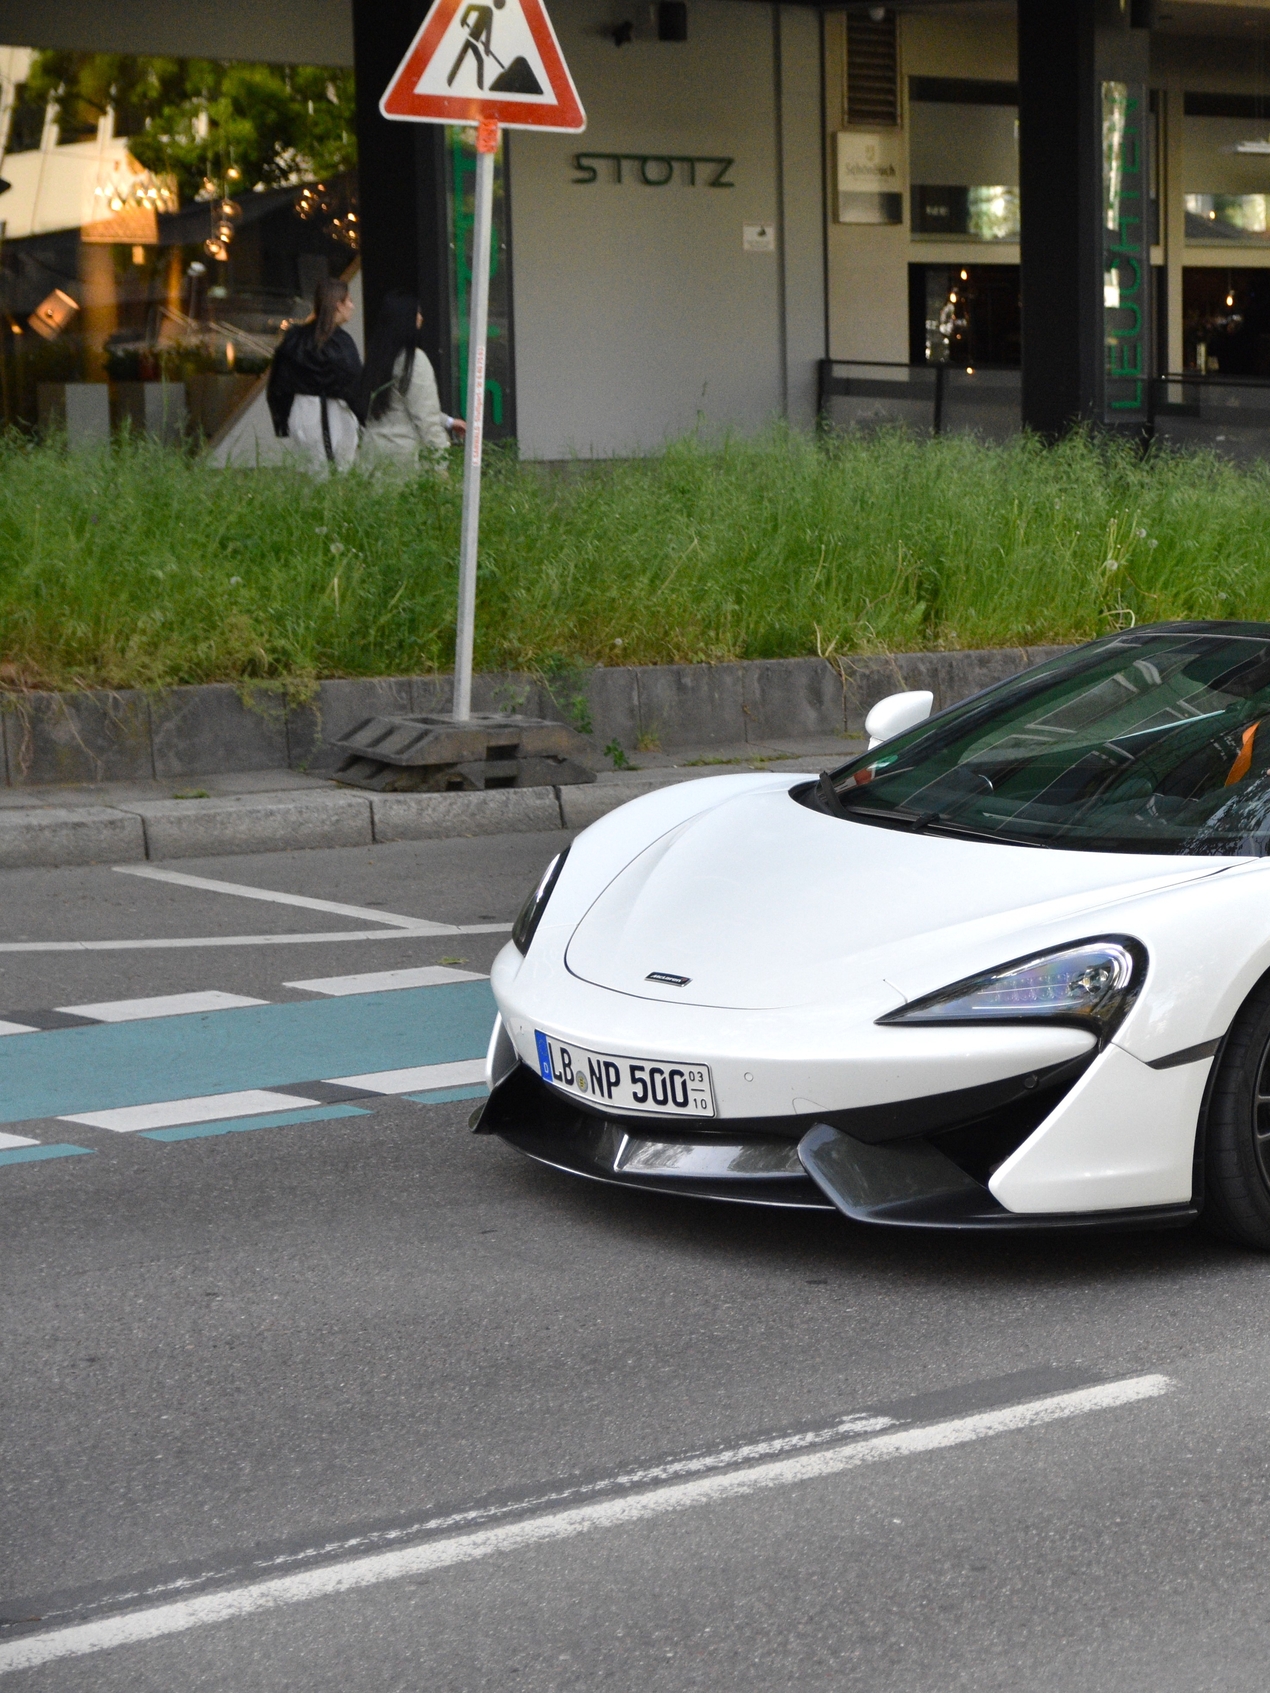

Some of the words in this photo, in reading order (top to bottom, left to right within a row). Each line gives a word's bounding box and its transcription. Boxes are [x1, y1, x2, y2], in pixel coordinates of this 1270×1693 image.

[572, 152, 735, 188] STOTZ
[1108, 97, 1142, 409] LEUCHTEN
[548, 1042, 575, 1086] LB
[588, 1056, 620, 1099] NP
[629, 1064, 689, 1108] 500
[689, 1070, 704, 1082] 03
[693, 1098, 707, 1110] 10
